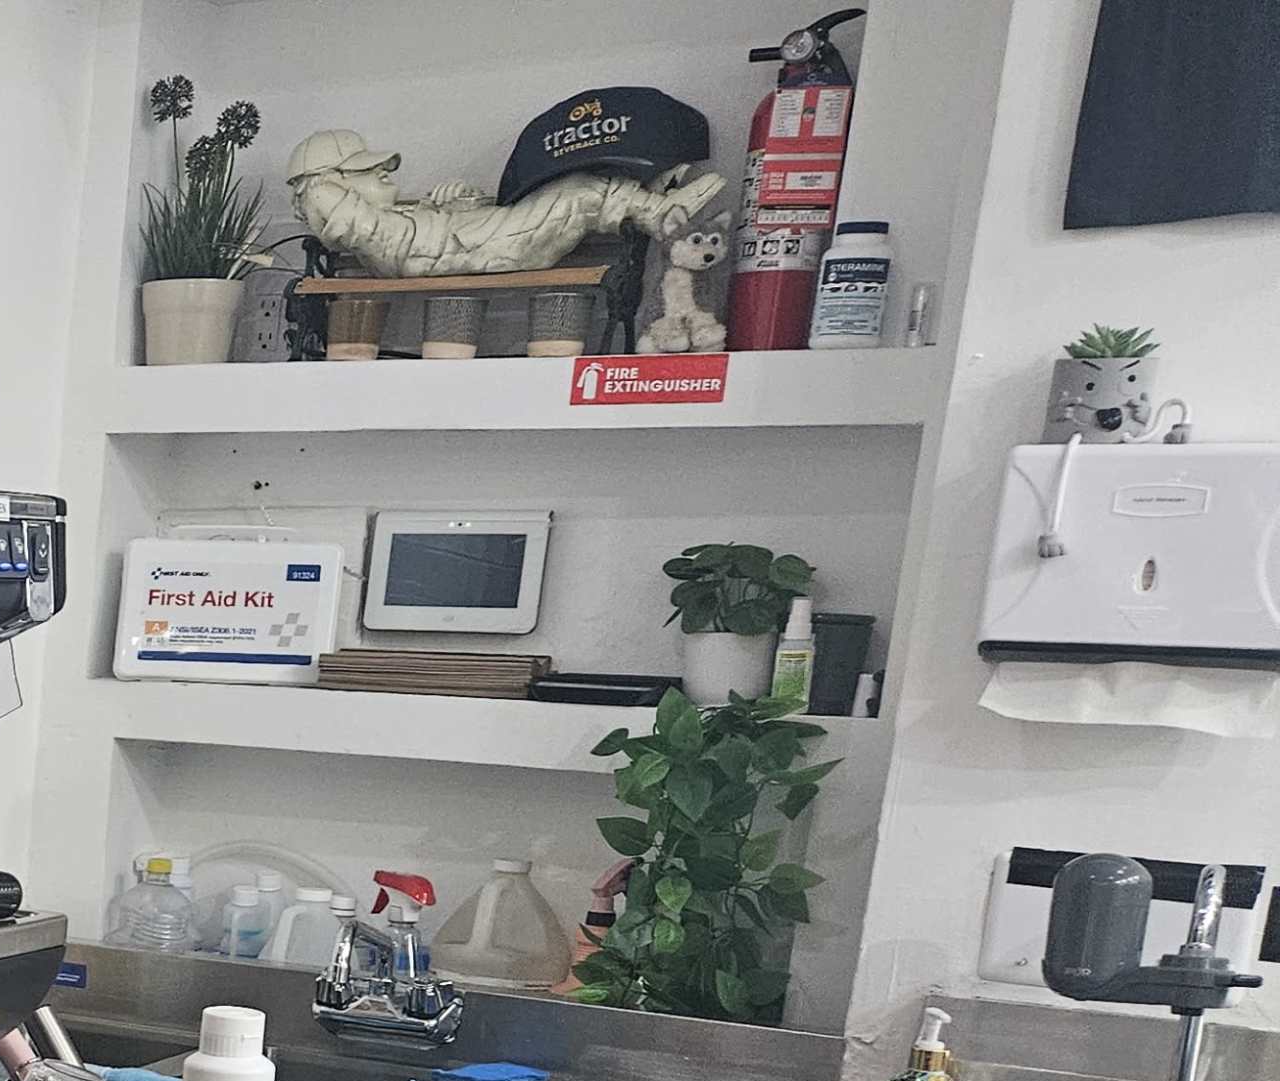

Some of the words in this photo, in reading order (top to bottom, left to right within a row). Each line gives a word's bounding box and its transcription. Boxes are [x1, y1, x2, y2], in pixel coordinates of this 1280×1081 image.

[543, 114, 632, 153] tractor
[606, 366, 639, 380] FIRE
[604, 378, 722, 396] EXTINGUISHER
[148, 589, 196, 607] First
[201, 590, 238, 608] Aid
[244, 591, 275, 608] Kit
